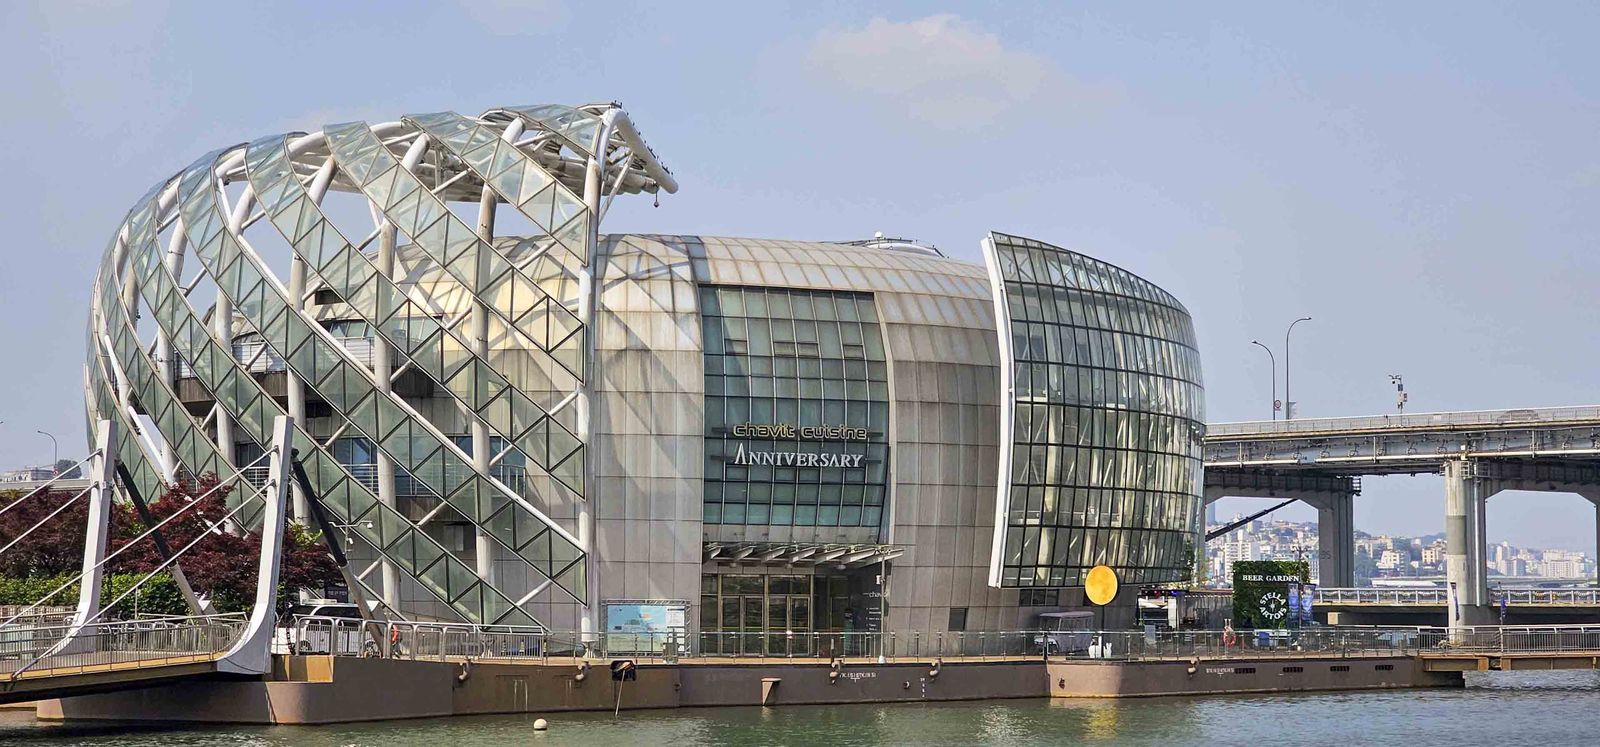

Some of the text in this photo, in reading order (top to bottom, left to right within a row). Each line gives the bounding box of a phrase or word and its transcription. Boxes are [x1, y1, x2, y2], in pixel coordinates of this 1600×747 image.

[733, 422, 867, 439] chavit cuisine
[735, 443, 863, 467] ANNIVERSARY
[1242, 574, 1264, 582] BEER
[1260, 592, 1287, 606] STELLA
[1260, 606, 1287, 620] ARTOIS
